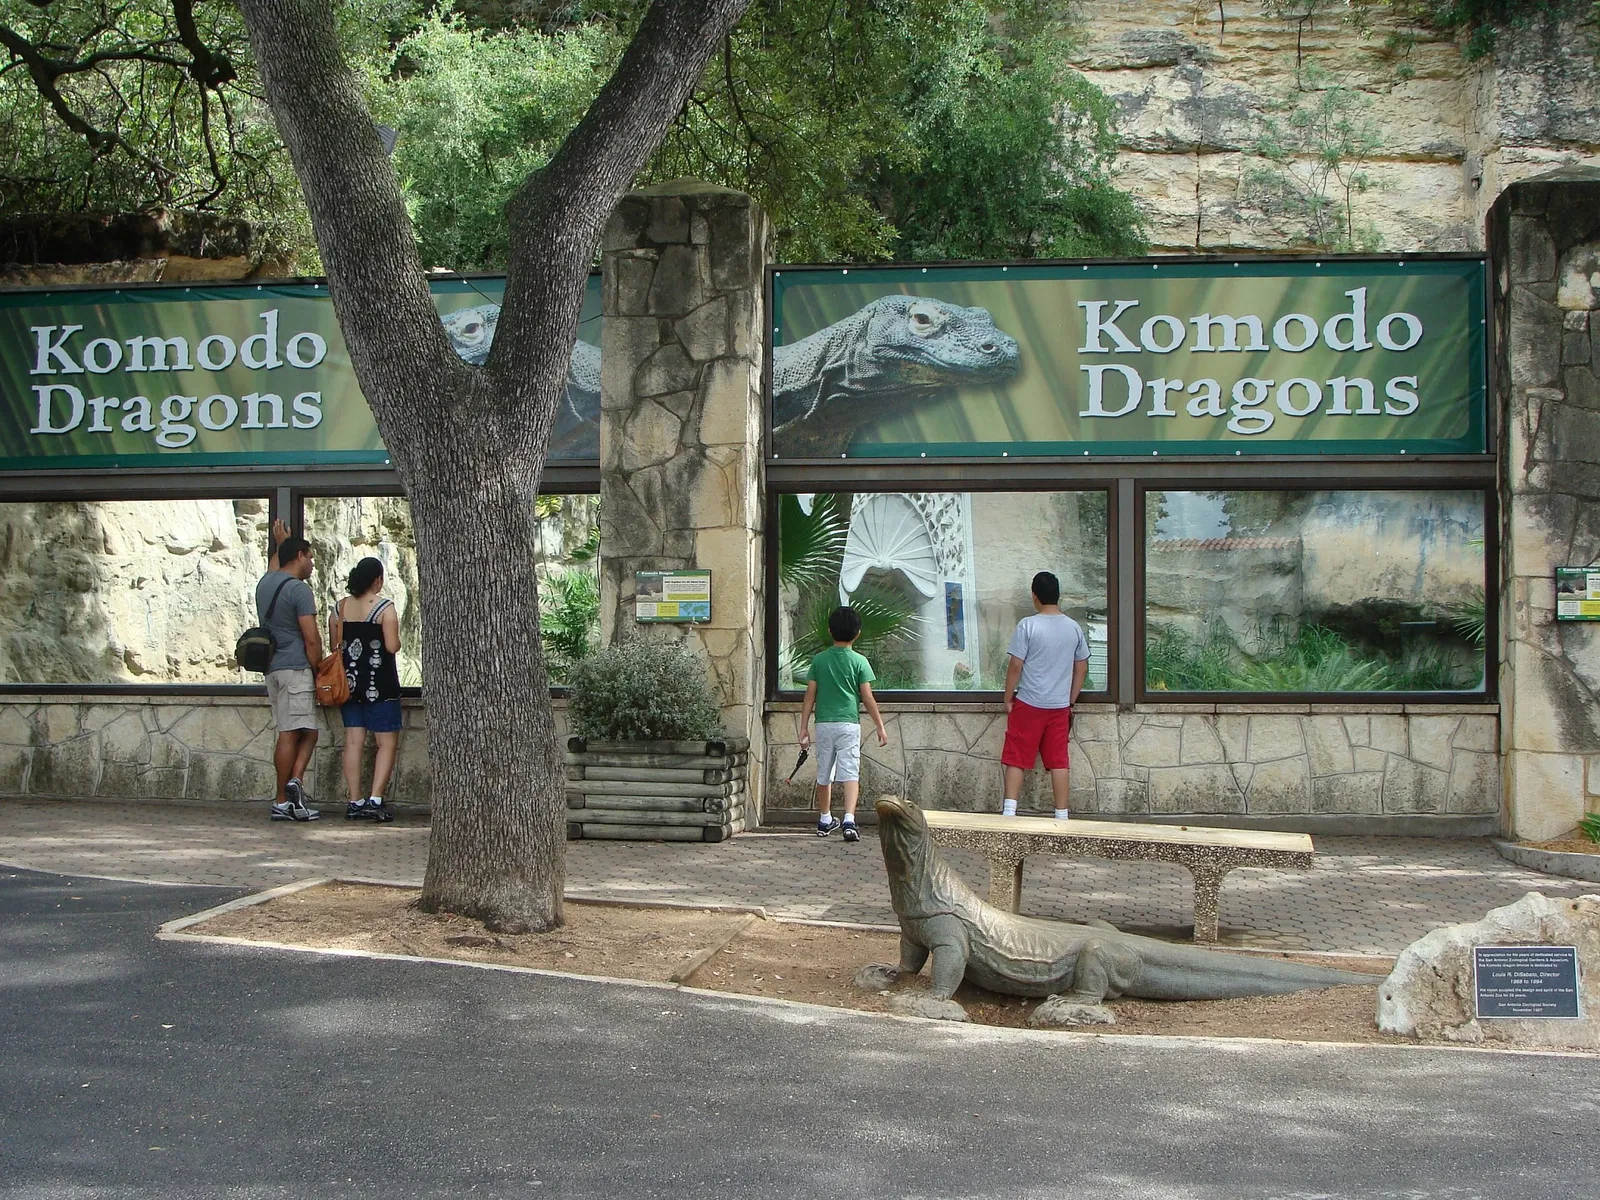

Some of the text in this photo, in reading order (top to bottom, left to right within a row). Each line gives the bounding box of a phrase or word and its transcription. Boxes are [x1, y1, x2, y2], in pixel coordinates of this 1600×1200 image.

[29, 309, 327, 375] Komodo
[1077, 287, 1423, 353] Komodo
[30, 384, 323, 448] Dragons
[1079, 364, 1420, 434] Dragons
